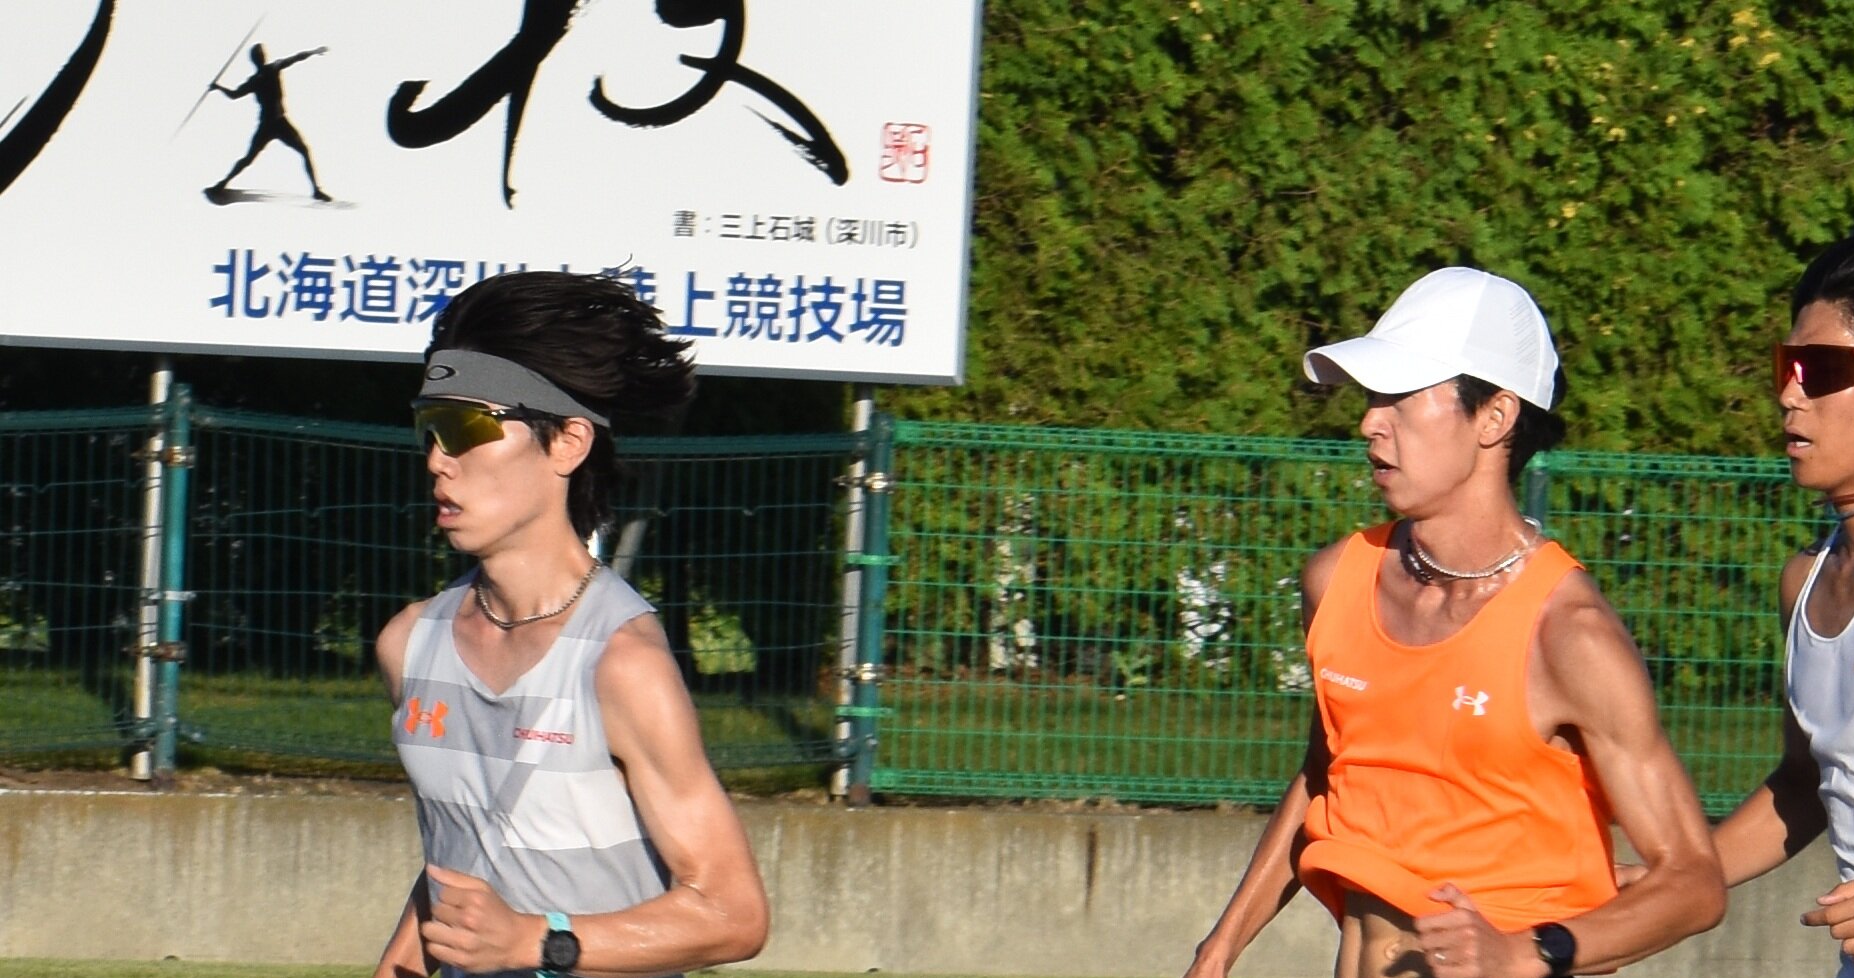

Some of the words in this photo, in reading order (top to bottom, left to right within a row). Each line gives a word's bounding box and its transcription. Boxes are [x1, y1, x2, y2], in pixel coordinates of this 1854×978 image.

[209, 248, 908, 347] 北海道深上競技場
